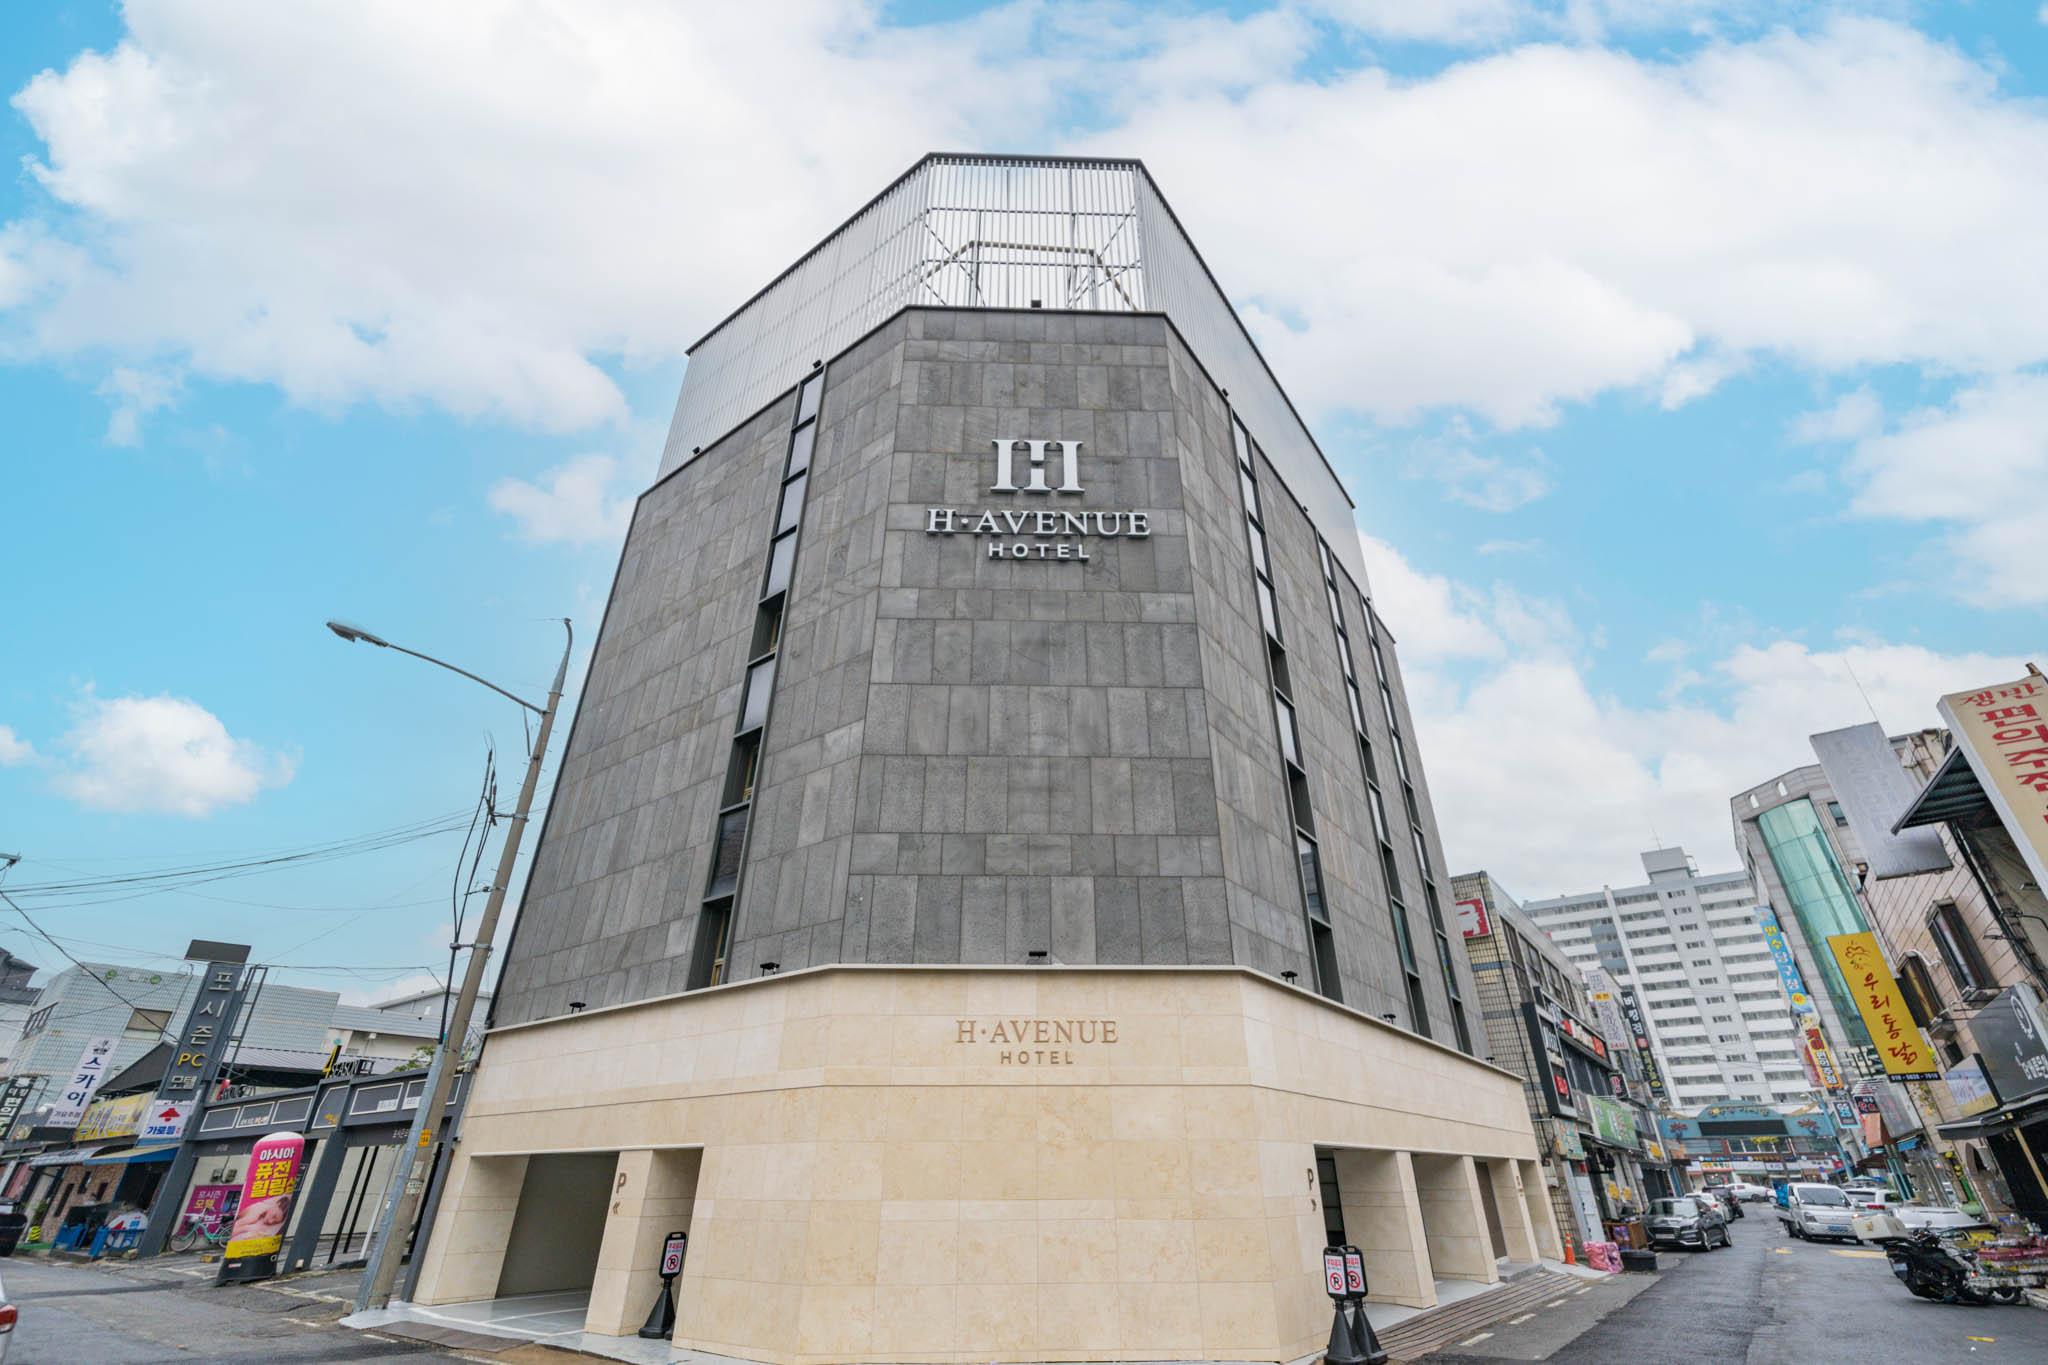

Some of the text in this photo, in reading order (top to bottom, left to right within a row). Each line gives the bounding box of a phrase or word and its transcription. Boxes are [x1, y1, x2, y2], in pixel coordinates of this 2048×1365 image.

[988, 542, 1090, 560] HOTEL
[1960, 683, 2043, 707] 쟁반
[191, 972, 233, 1046] 포시즌
[177, 1053, 206, 1067] PC
[1000, 1051, 1073, 1065] HOTEL
[67, 1057, 101, 1107] 스카이
[168, 1075, 197, 1091] 모텔
[259, 1147, 295, 1161] 아시아
[255, 1160, 293, 1180] 퓨전
[1307, 1168, 1314, 1190] P
[616, 1172, 627, 1194] P
